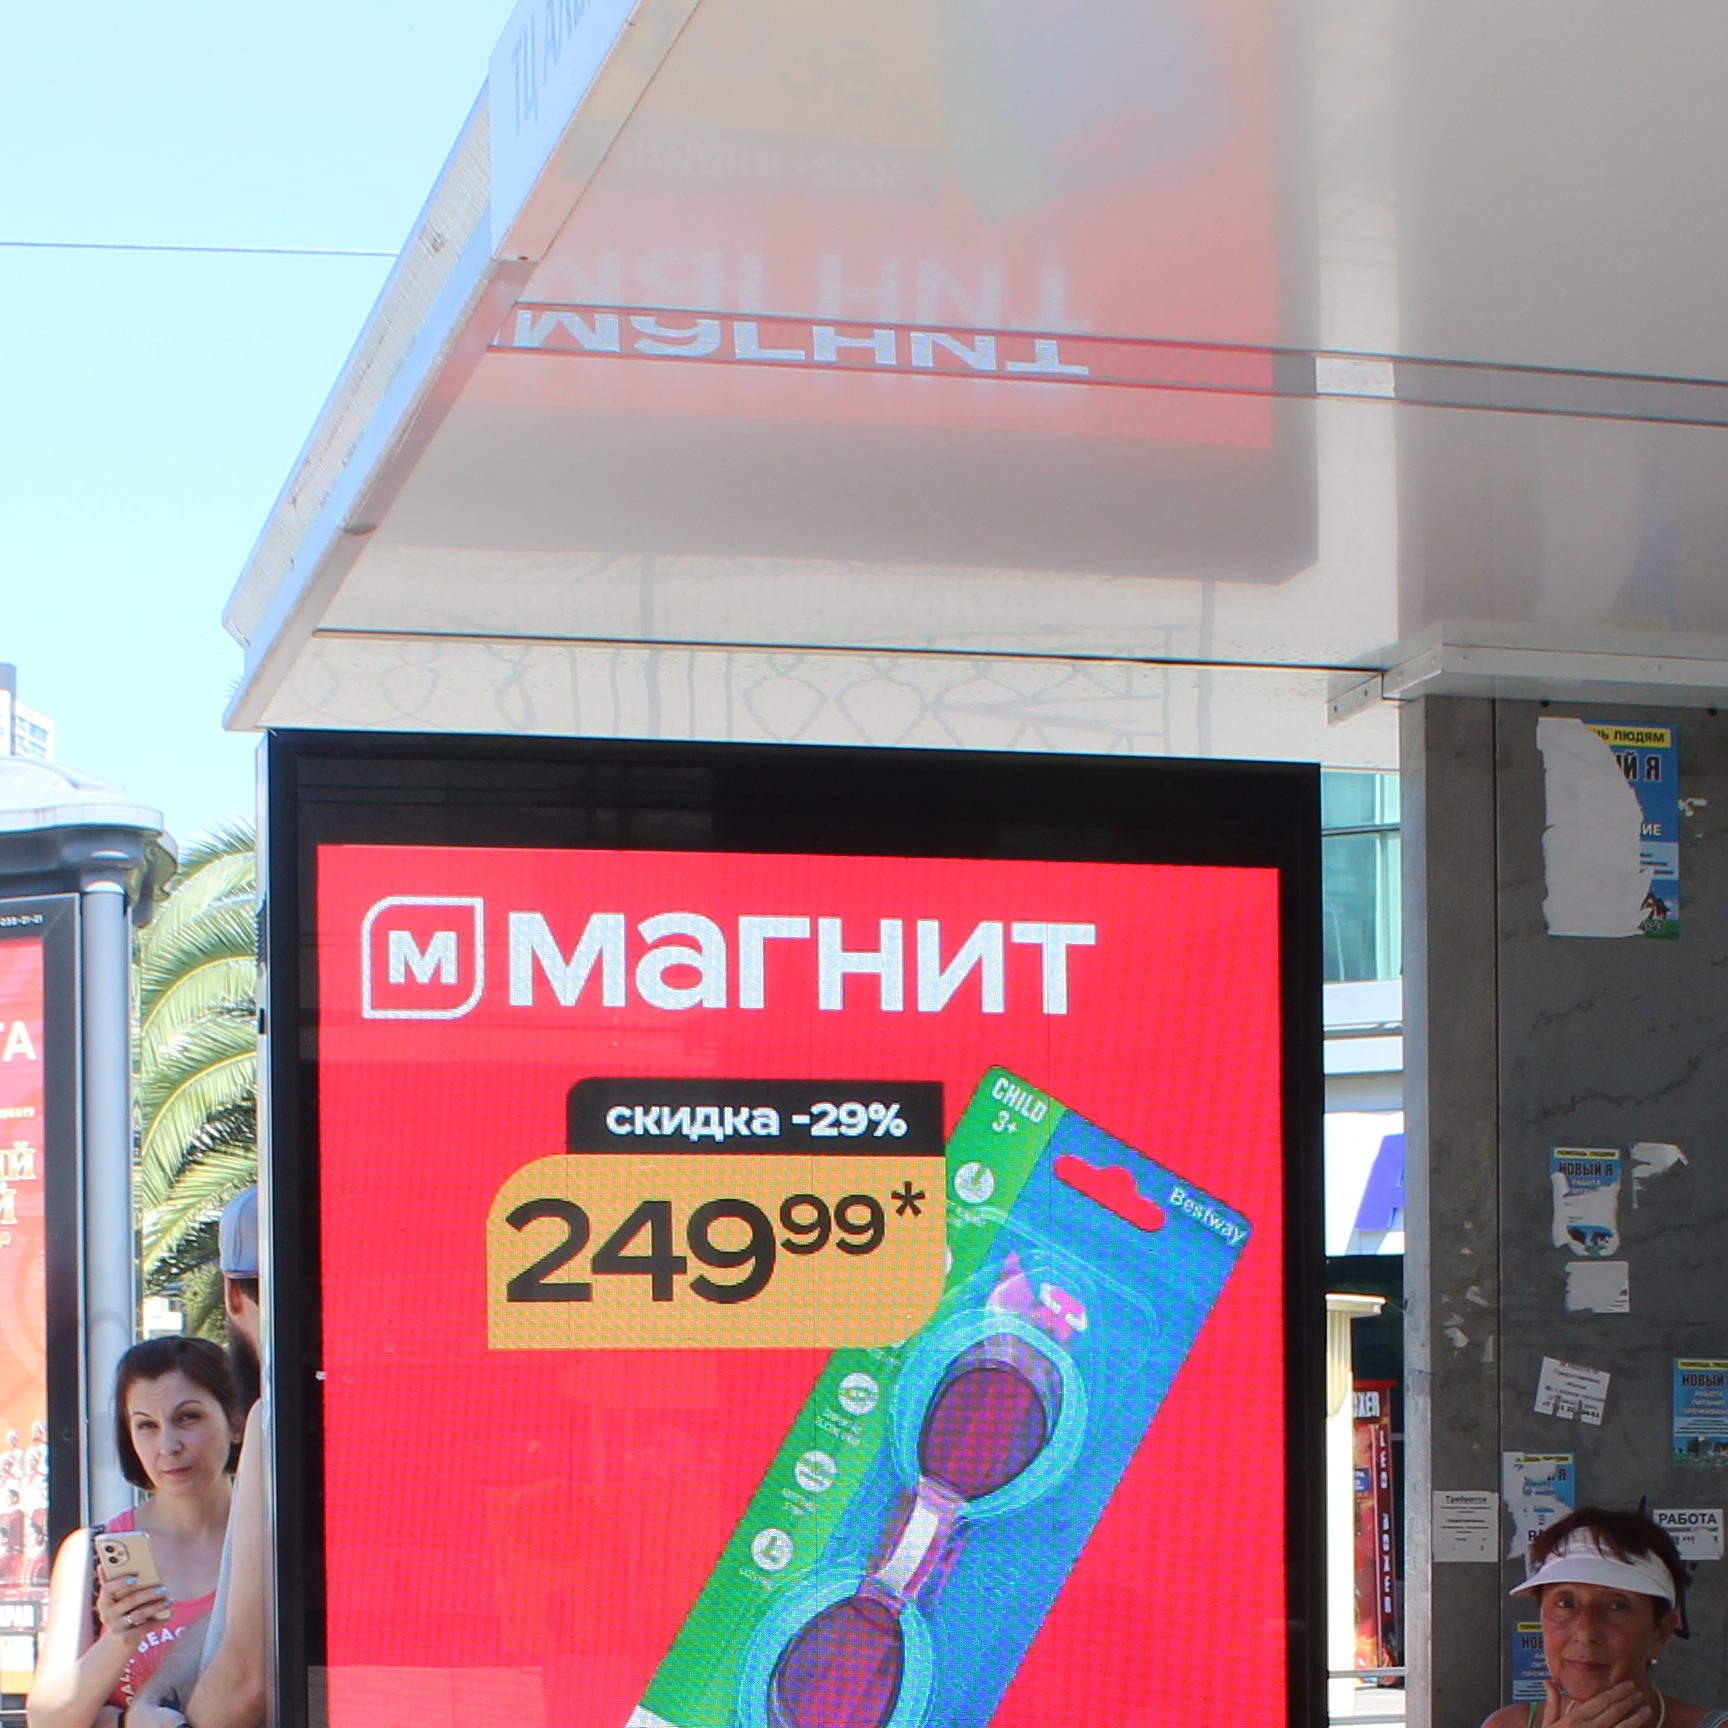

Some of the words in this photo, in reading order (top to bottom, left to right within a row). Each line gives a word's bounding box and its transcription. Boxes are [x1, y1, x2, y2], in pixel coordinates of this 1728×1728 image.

[1613, 730, 1665, 743] ЛЮДЯМ
[605, 1101, 781, 1141] скидка
[791, 1101, 908, 1137] -29%
[1169, 1186, 1247, 1246] Bestway
[1681, 1373, 1725, 1388] НОВЫЙ
[1658, 1513, 1718, 1525] РАБОТА
